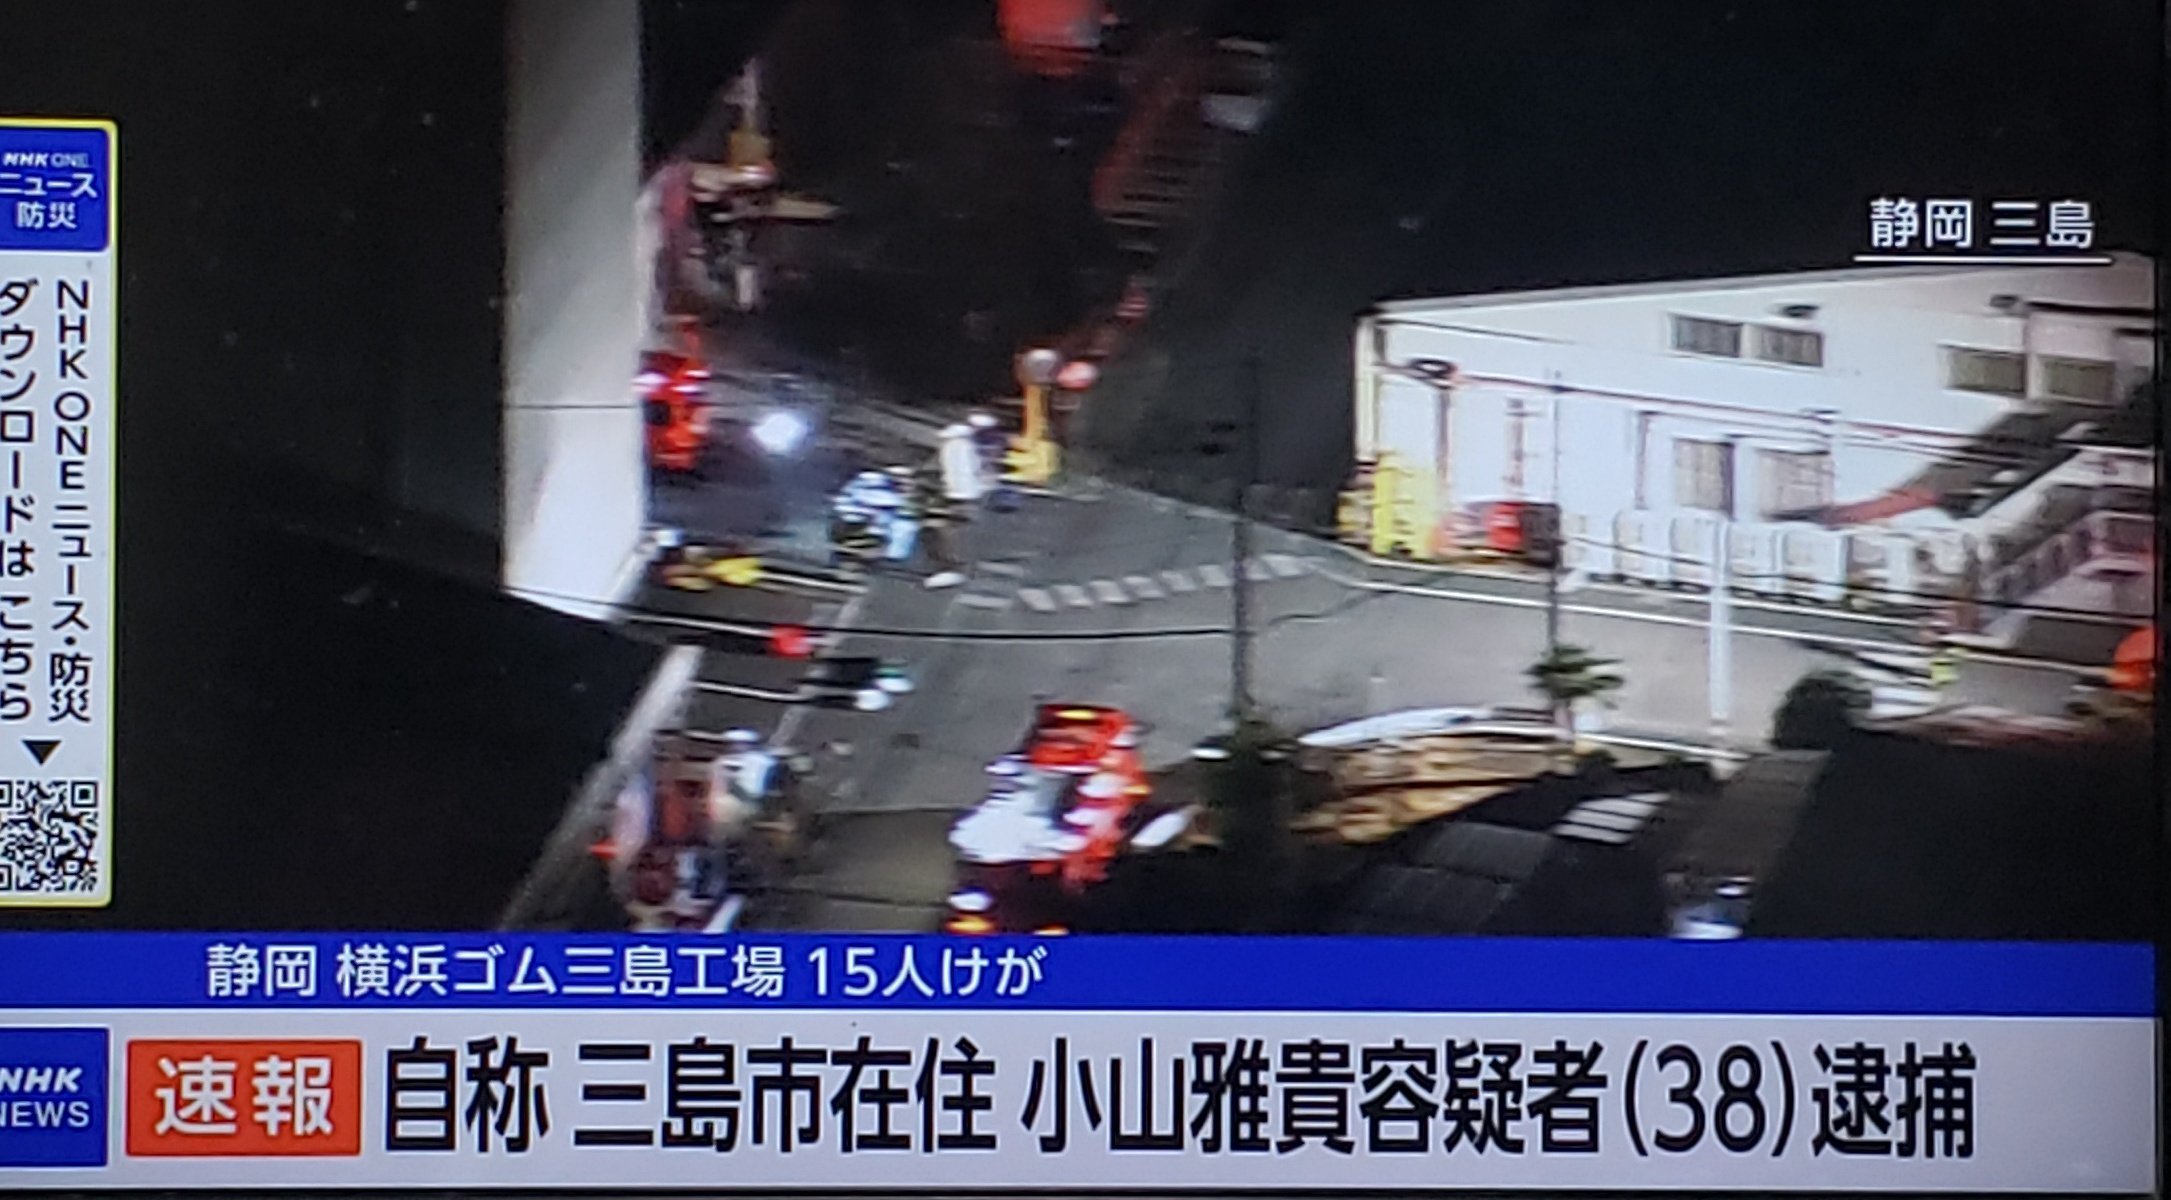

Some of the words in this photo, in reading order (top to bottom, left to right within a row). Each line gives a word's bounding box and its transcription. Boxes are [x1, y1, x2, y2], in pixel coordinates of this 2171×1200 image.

[0, 173, 98, 198] ニュース
[3, 152, 48, 167] NHK
[50, 152, 89, 168] ONE
[17, 201, 77, 229] 防災
[1869, 197, 1974, 249] 静岡
[1989, 199, 2095, 249] 三島
[57, 279, 89, 380] NHK
[0, 277, 39, 578] ダウンロードは
[48, 504, 92, 723] ニュース・防災
[0, 595, 34, 720] こちら
[206, 942, 318, 998] 静岡
[335, 942, 787, 998] 横浜ゴム三島工場
[807, 943, 1049, 998] 15人けが
[0, 1066, 83, 1093] NHK
[155, 1054, 334, 1136] 速報
[384, 1035, 550, 1154] 自称
[573, 1035, 998, 1154] 三島市在住
